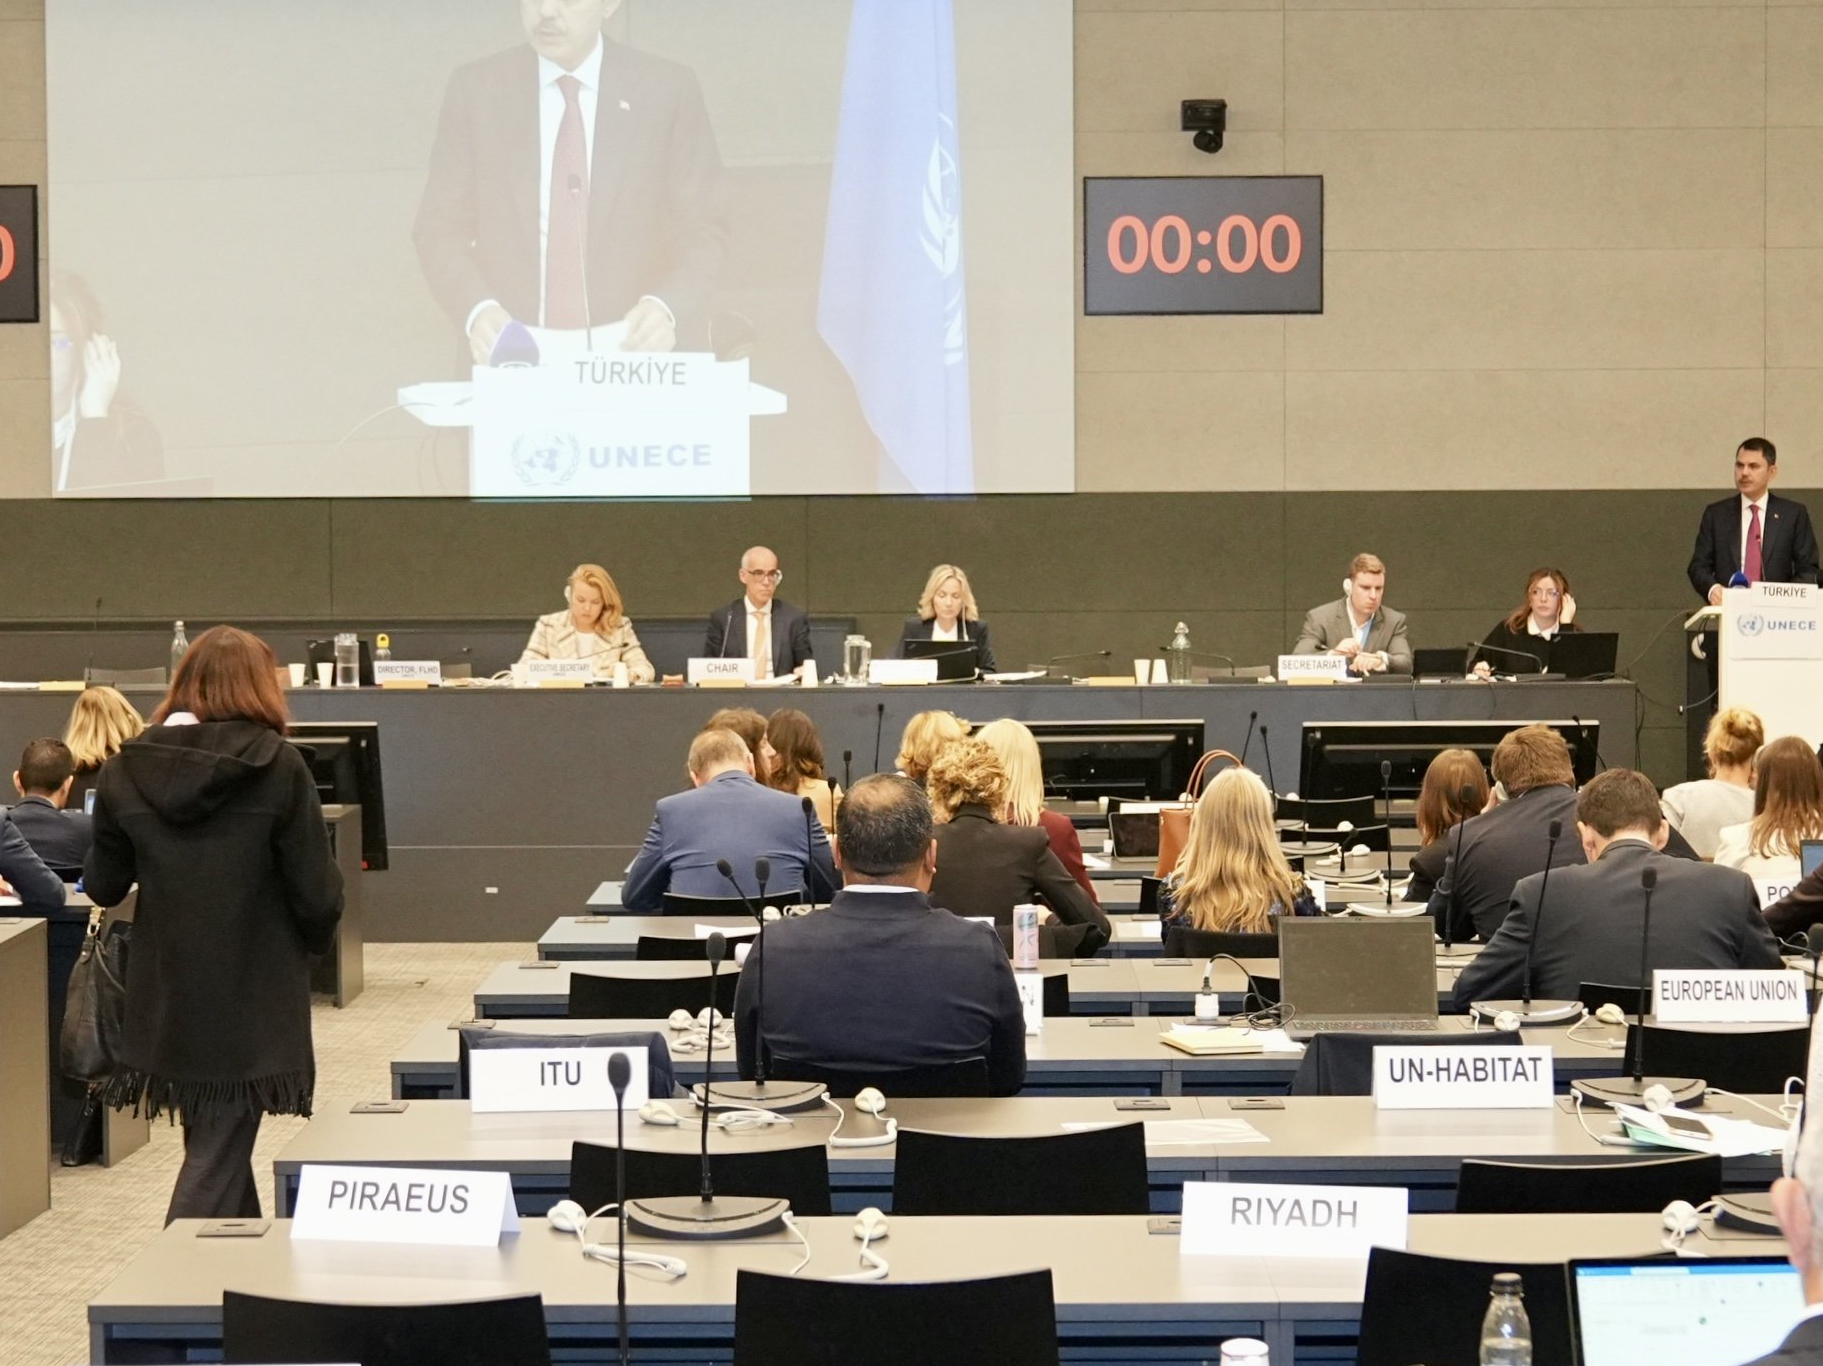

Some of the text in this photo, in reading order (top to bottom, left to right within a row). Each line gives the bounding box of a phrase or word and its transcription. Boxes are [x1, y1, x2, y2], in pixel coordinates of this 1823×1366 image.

[1107, 214, 1302, 274] 00:00
[575, 356, 687, 385] TÜRKİYE
[590, 444, 711, 469] UNECE
[1762, 585, 1807, 598] TÜRKİYE
[1767, 621, 1817, 631] UNECE
[707, 663, 739, 674] CHAIR
[1282, 660, 1342, 671] SECRETARIAT
[1662, 980, 1798, 1001] EUROPEAN UNION
[539, 1061, 582, 1088] ITU
[1388, 1058, 1543, 1084] UN-HABITAT
[327, 1180, 471, 1215] PIRAEUS
[1229, 1196, 1359, 1229] RIYADH
